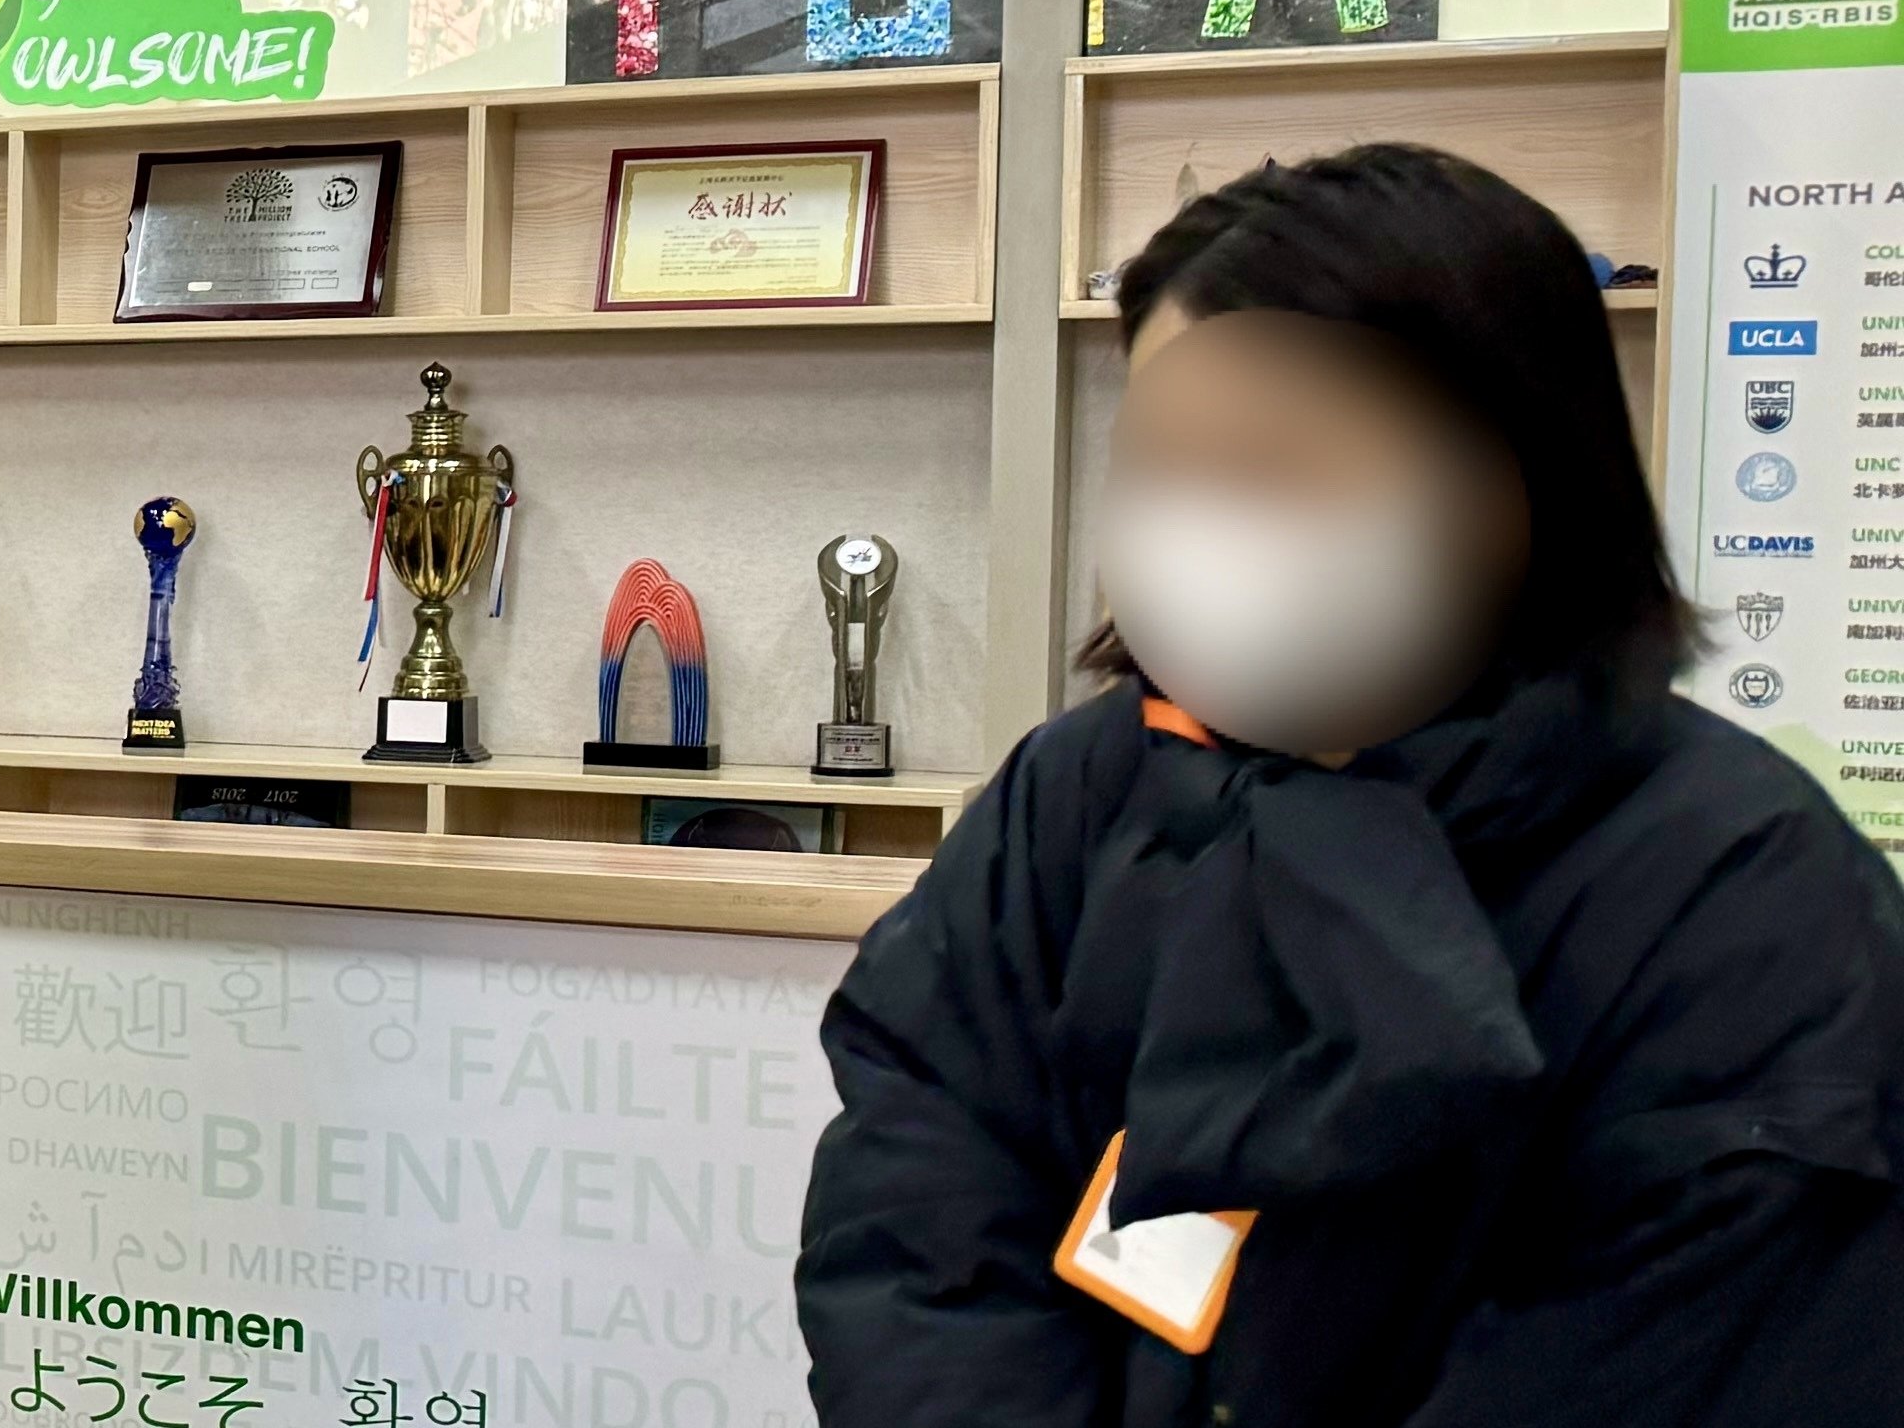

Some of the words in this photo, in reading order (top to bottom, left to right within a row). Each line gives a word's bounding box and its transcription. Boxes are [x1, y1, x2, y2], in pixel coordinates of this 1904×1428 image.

[12, 22, 310, 93] OWLSOME!
[1748, 182, 1873, 208] NORTH
[1741, 328, 1806, 348] UCLA
[1750, 382, 1791, 395] UBC
[1854, 457, 1901, 472] UNC
[448, 1009, 801, 1131] FÁILTE
[7, 1136, 189, 1185] DHAWEYN
